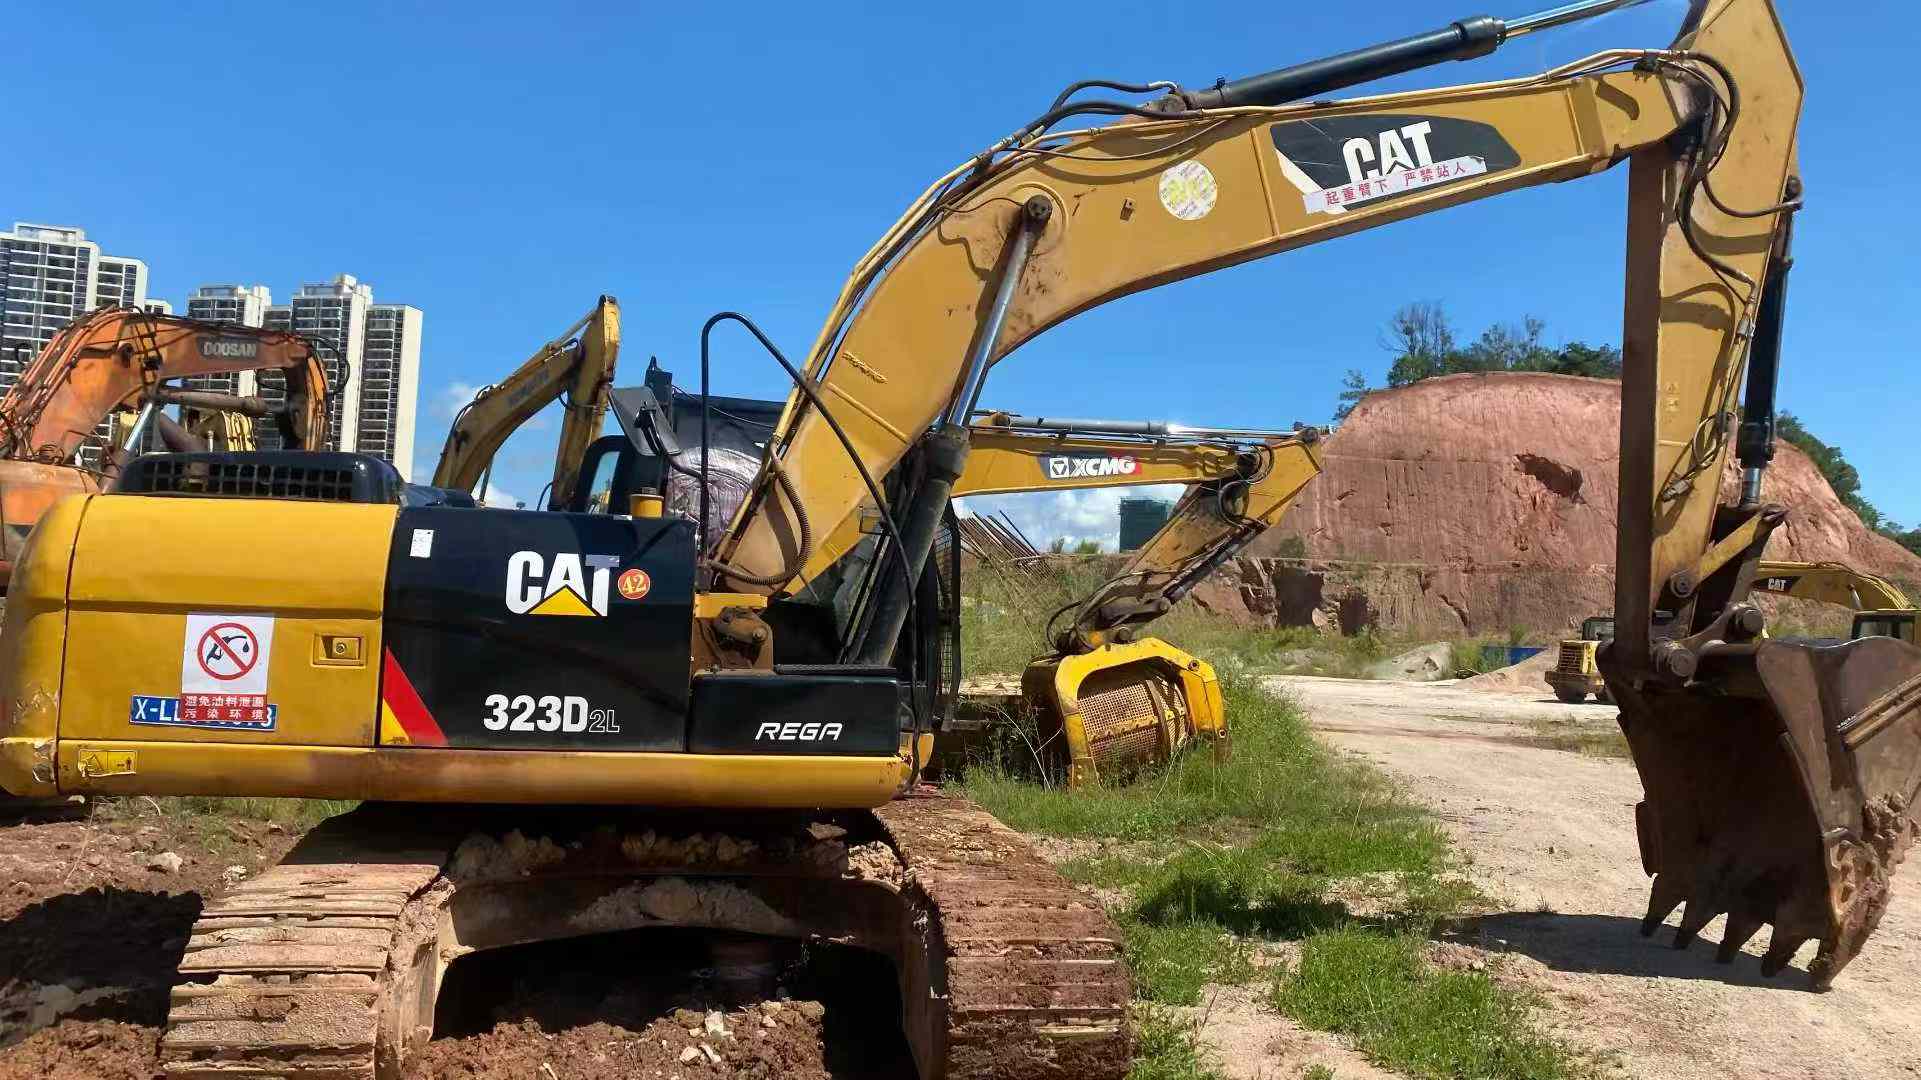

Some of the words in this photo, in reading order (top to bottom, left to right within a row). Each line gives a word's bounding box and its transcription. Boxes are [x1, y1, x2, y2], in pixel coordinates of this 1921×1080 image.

[1342, 120, 1432, 184] CAT
[1324, 178, 1388, 206] 起重臂下
[1404, 161, 1466, 186] 严禁站人
[202, 341, 257, 357] DOOSAN
[1070, 456, 1136, 477] XCMG
[505, 550, 620, 617] CAT
[622, 572, 648, 595] 42
[1768, 577, 1786, 592] CAT
[184, 708, 264, 721] 污染环境
[754, 722, 843, 741] REGA
